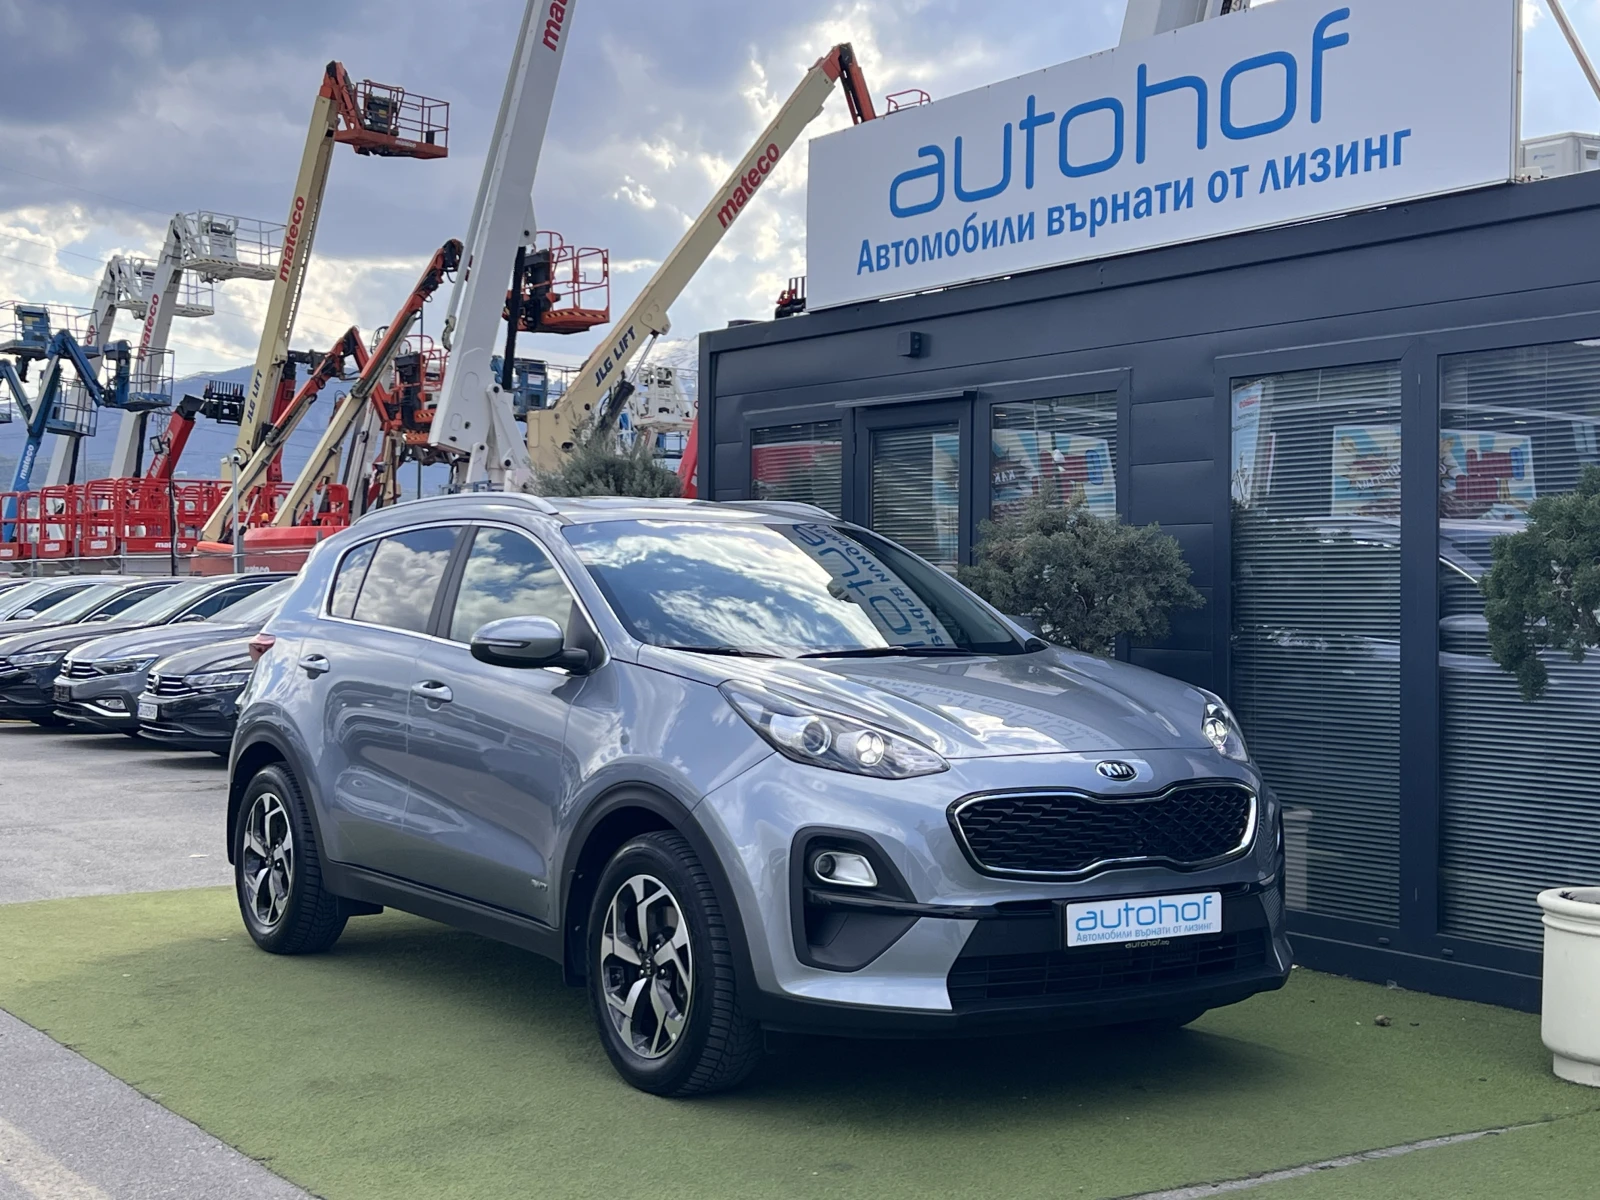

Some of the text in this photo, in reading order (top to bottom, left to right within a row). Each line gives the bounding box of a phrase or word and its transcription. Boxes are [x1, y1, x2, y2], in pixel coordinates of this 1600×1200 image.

[890, 7, 1350, 218] autohof
[717, 143, 779, 228] mateco
[857, 128, 1411, 275] Автомобили върнати от лизинг
[280, 196, 305, 282] mateco
[595, 325, 635, 387] JLG LIFT
[252, 369, 262, 398] LIFT
[20, 444, 35, 479] mateco
[1102, 762, 1134, 776] KIA
[1075, 895, 1212, 931] autohof
[1076, 922, 1213, 942] Автомобили върнати от лизинг
